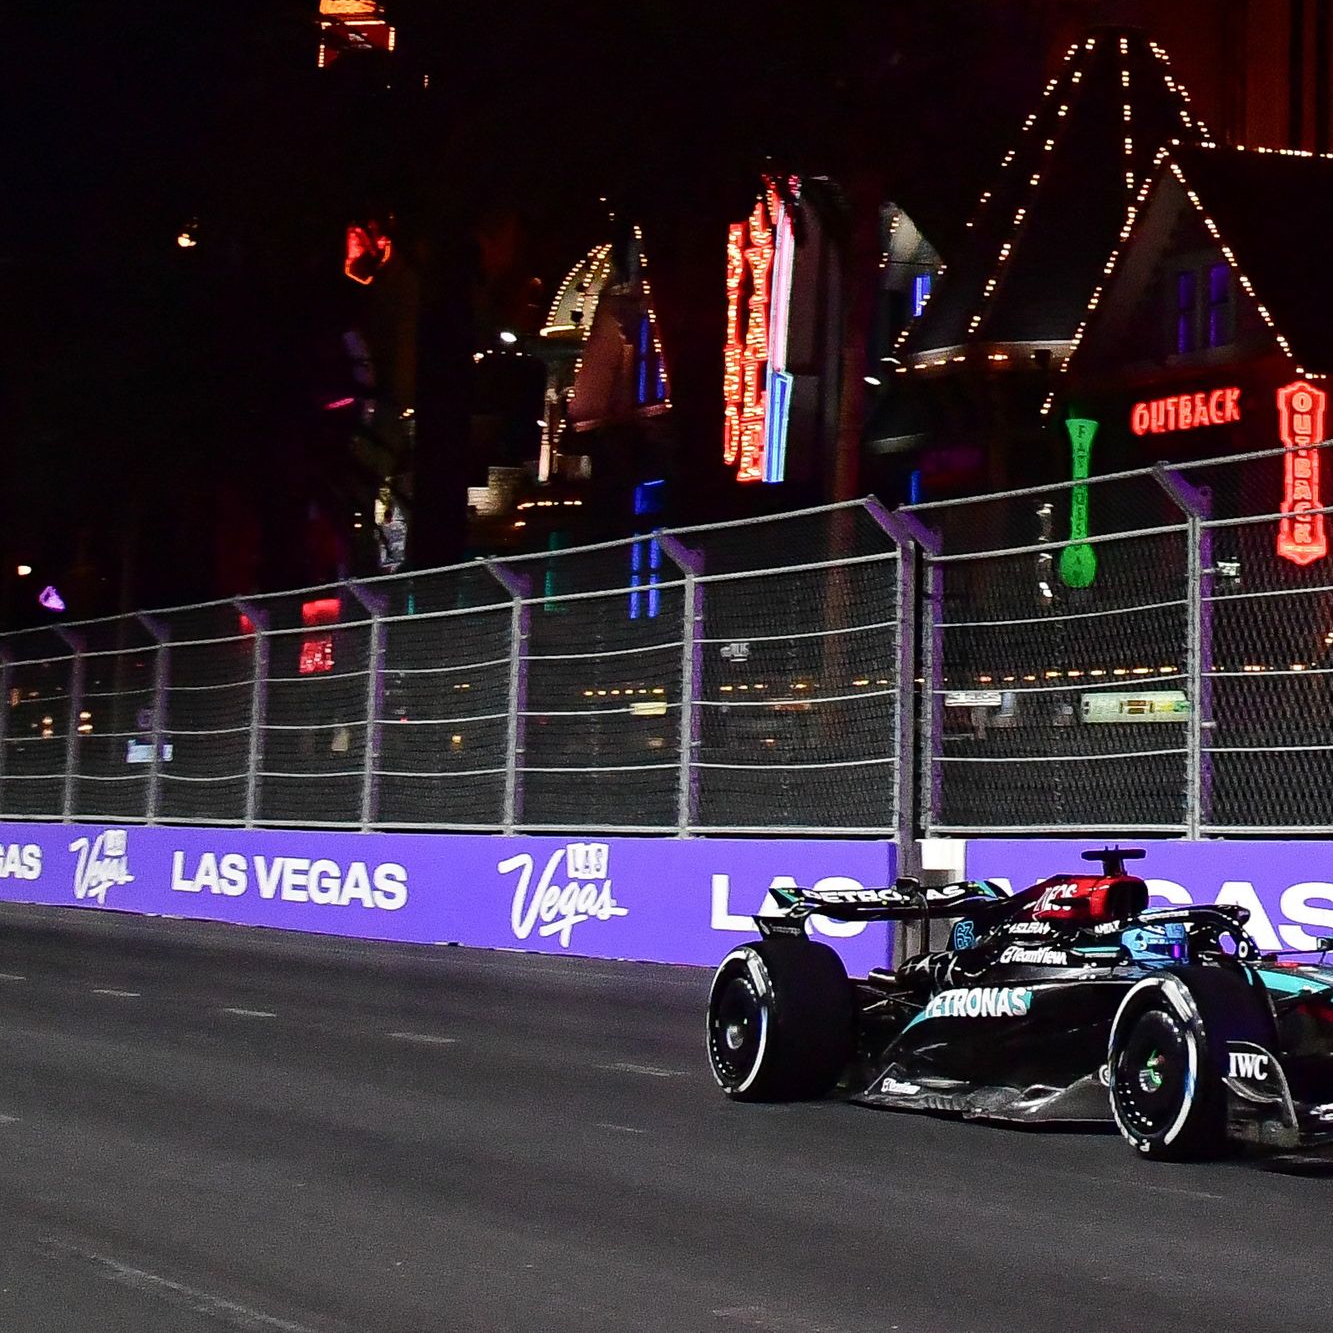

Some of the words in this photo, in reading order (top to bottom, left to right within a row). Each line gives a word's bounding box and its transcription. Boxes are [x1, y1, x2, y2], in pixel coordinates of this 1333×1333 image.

[1131, 387, 1242, 436] OUTBACK
[1290, 391, 1314, 545] OUTBACK
[0, 842, 42, 880] AS
[171, 850, 248, 896] LAS
[253, 855, 408, 910] VEGAS
[498, 848, 628, 948] Vegas
[802, 881, 966, 905] PETROAS
[925, 987, 1028, 1018] PETRONAS
[1228, 1052, 1269, 1081] IWC
